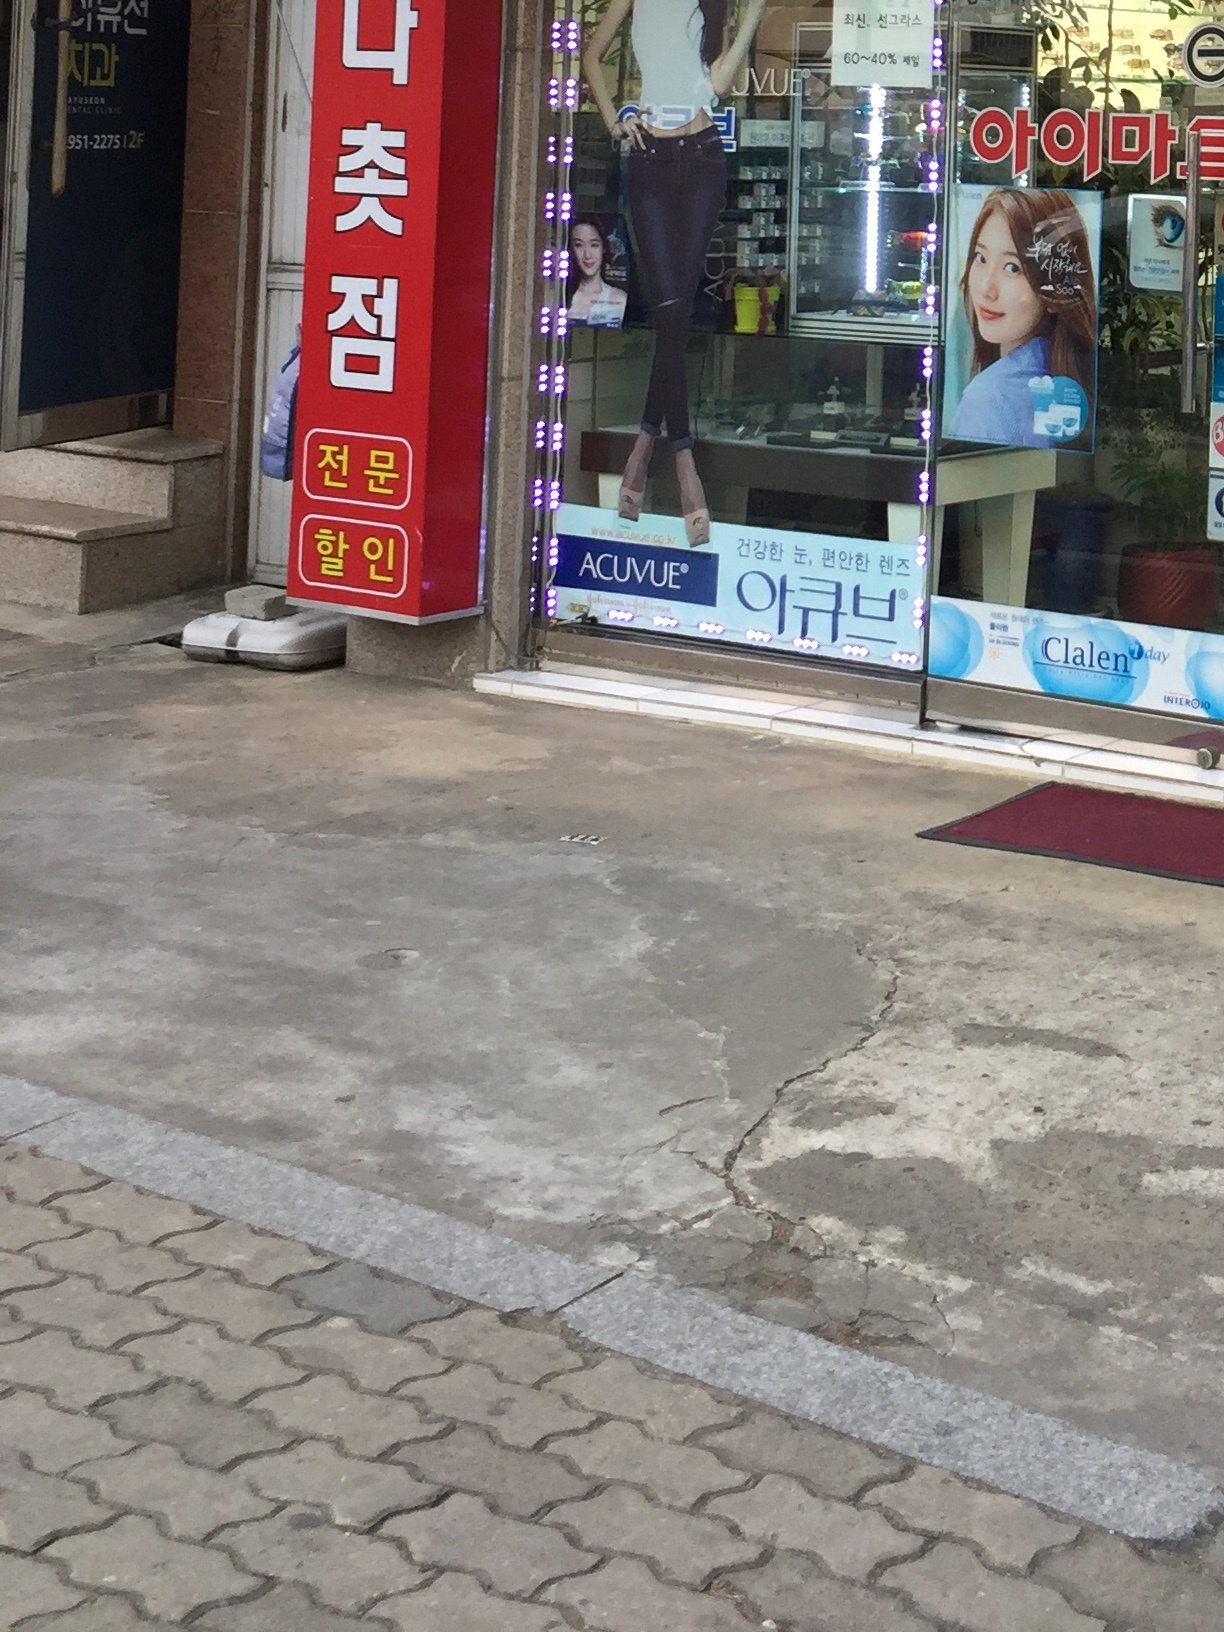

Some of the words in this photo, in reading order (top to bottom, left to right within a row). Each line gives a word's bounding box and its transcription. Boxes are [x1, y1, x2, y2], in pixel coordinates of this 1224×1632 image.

[877, 14, 922, 29] 선그라스
[843, 52, 897, 65] 60~40%
[902, 55, 919, 67] 세일
[68, 133, 121, 150] 951-2275
[317, 443, 400, 496] 전문
[591, 527, 677, 545] www.acuvue.co.kr
[313, 528, 395, 583] 할인
[737, 538, 784, 562] 건강한
[794, 545, 813, 566] 눈,
[822, 548, 870, 572] 편안한
[880, 555, 910, 577] 렌즈
[1041, 637, 1130, 674] Clalen
